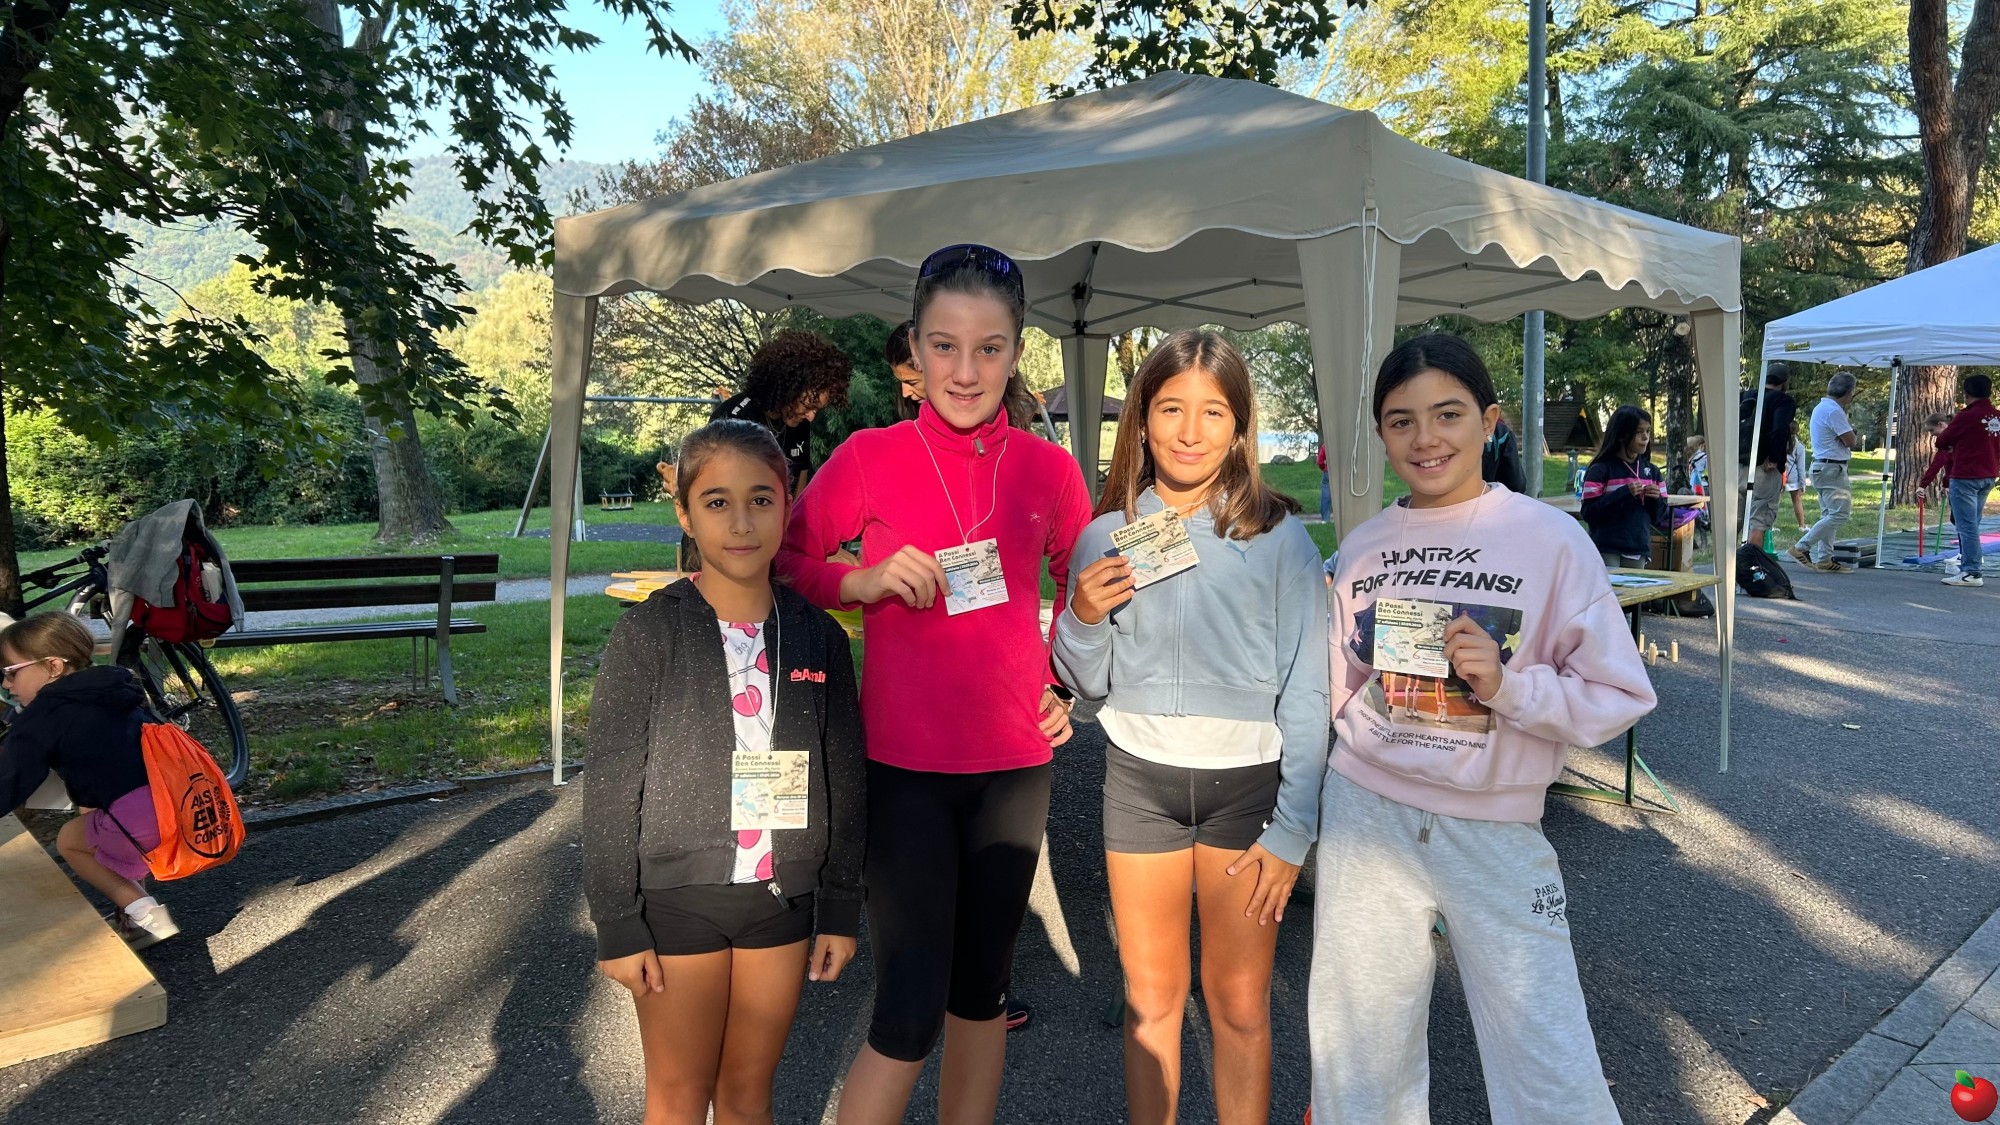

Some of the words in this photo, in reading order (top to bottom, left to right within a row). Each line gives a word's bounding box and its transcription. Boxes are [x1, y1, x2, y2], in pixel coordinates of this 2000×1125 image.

[1115, 534, 1128, 542] Ben
[1128, 522, 1154, 537] Connessi
[1118, 526, 1136, 535] Passi
[952, 551, 976, 560] Connessi
[1352, 573, 1389, 599] FOR
[1392, 570, 1440, 586] THE
[1440, 570, 1523, 594] FANS!
[1372, 730, 1396, 744] BATTLE
[1432, 744, 1456, 752] FANS!
[1415, 733, 1448, 744] HEARTS
[1450, 738, 1468, 746] AND
[1534, 883, 1559, 898] PARIS
[1532, 899, 1544, 914] Le
